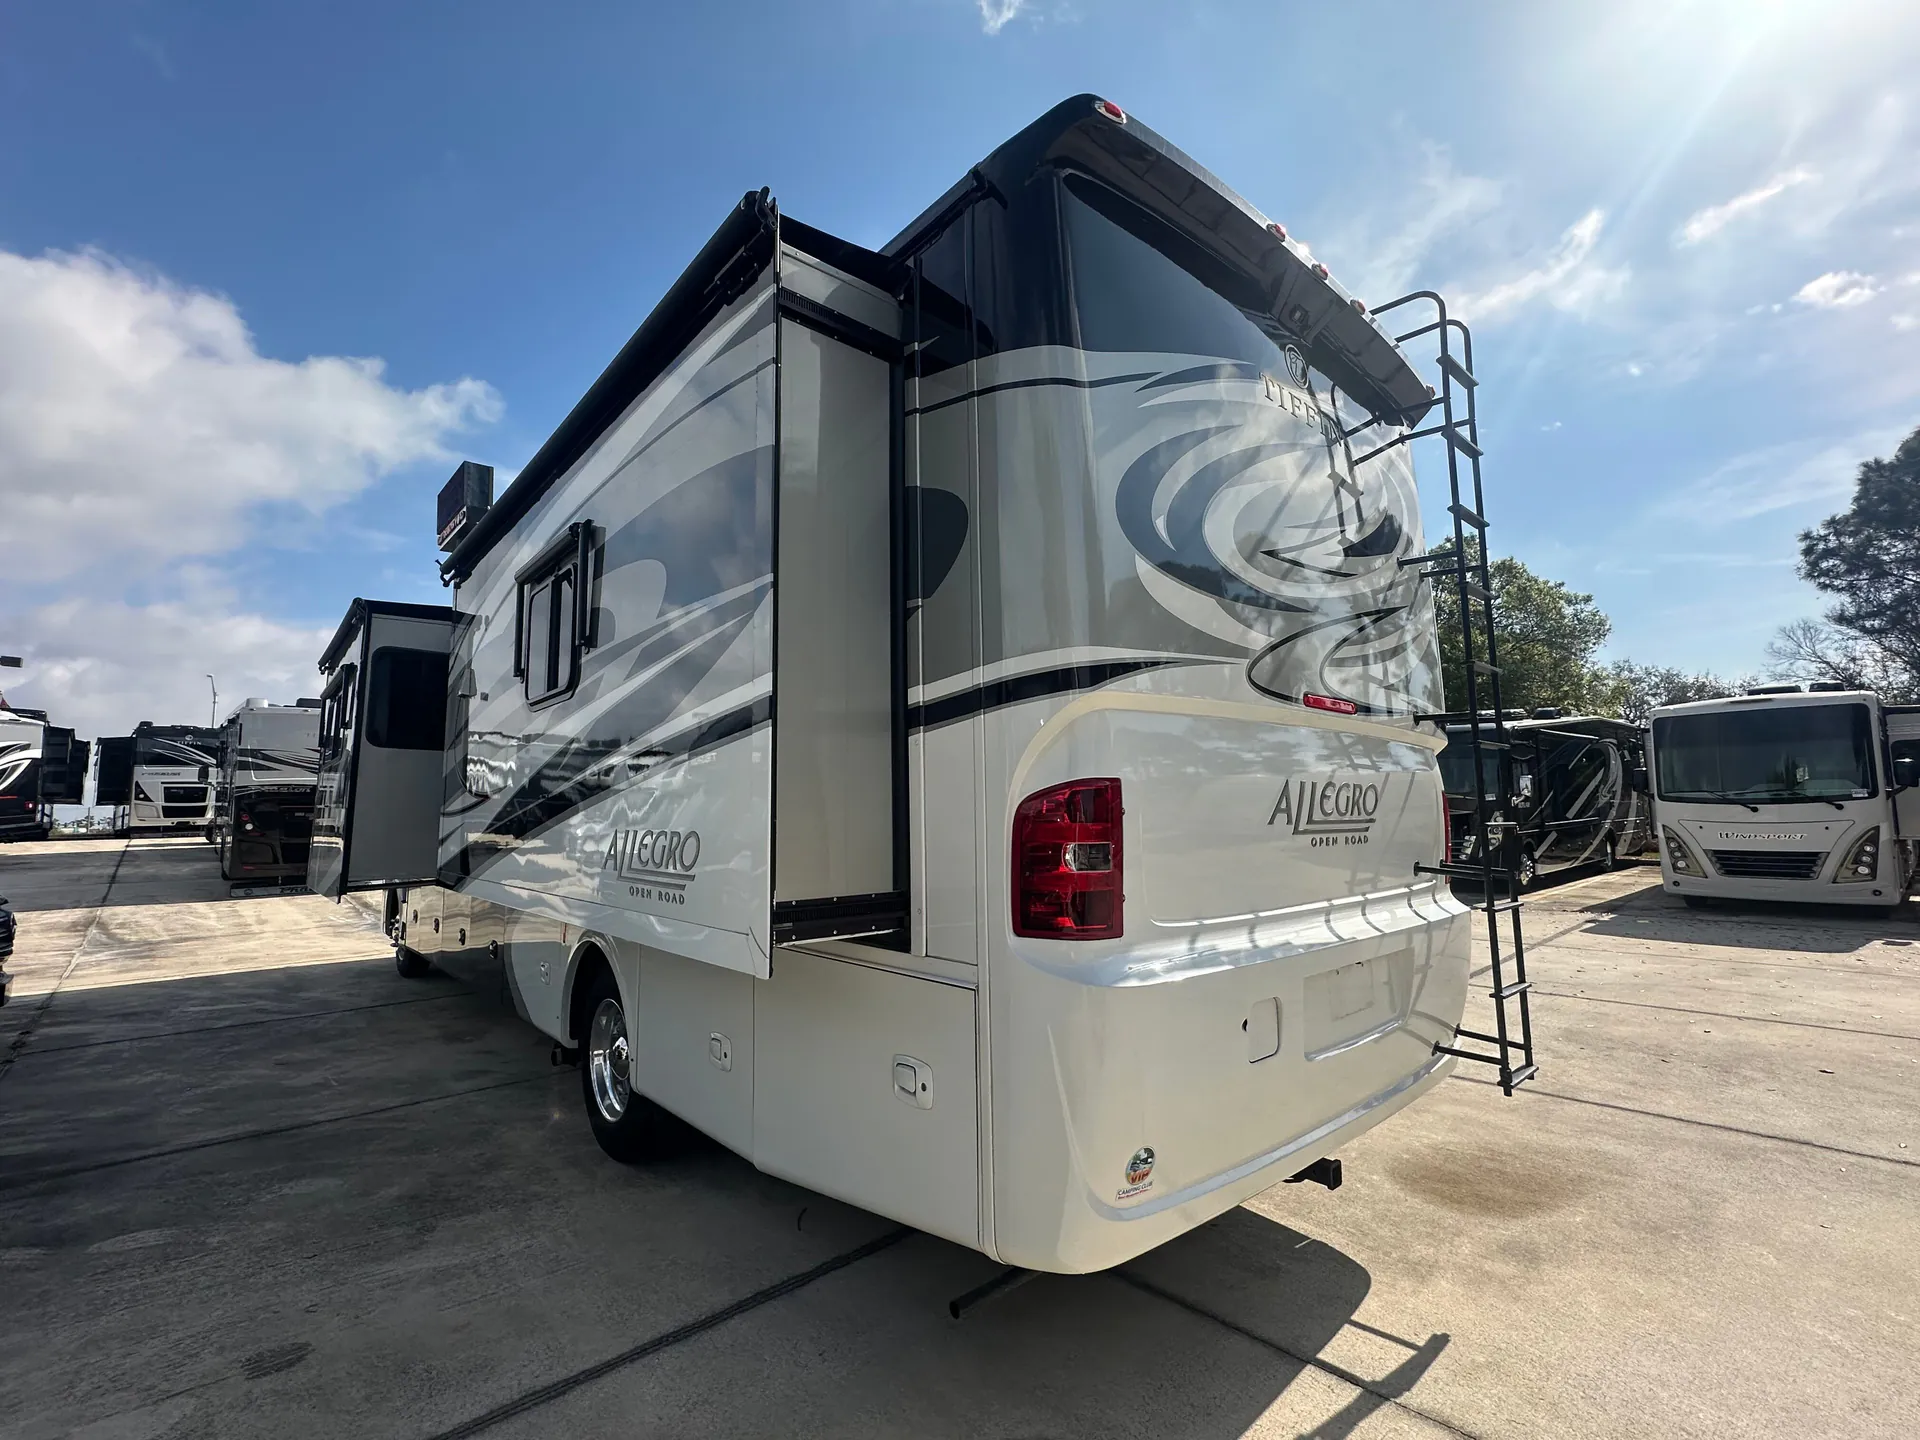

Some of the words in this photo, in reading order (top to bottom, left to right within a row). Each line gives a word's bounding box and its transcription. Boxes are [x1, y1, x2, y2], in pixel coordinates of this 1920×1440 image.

[1258, 371, 1343, 447] TIFFIN
[1267, 779, 1379, 835] ALLEGRO
[1311, 836, 1338, 848] OPEN
[1344, 835, 1369, 846] ROAD
[1718, 831, 1807, 840] WINDSPORT
[602, 828, 701, 891] ALLEGRO
[629, 886, 652, 900] OPEN
[658, 890, 685, 905] ROAD
[1130, 1168, 1152, 1184] VIP
